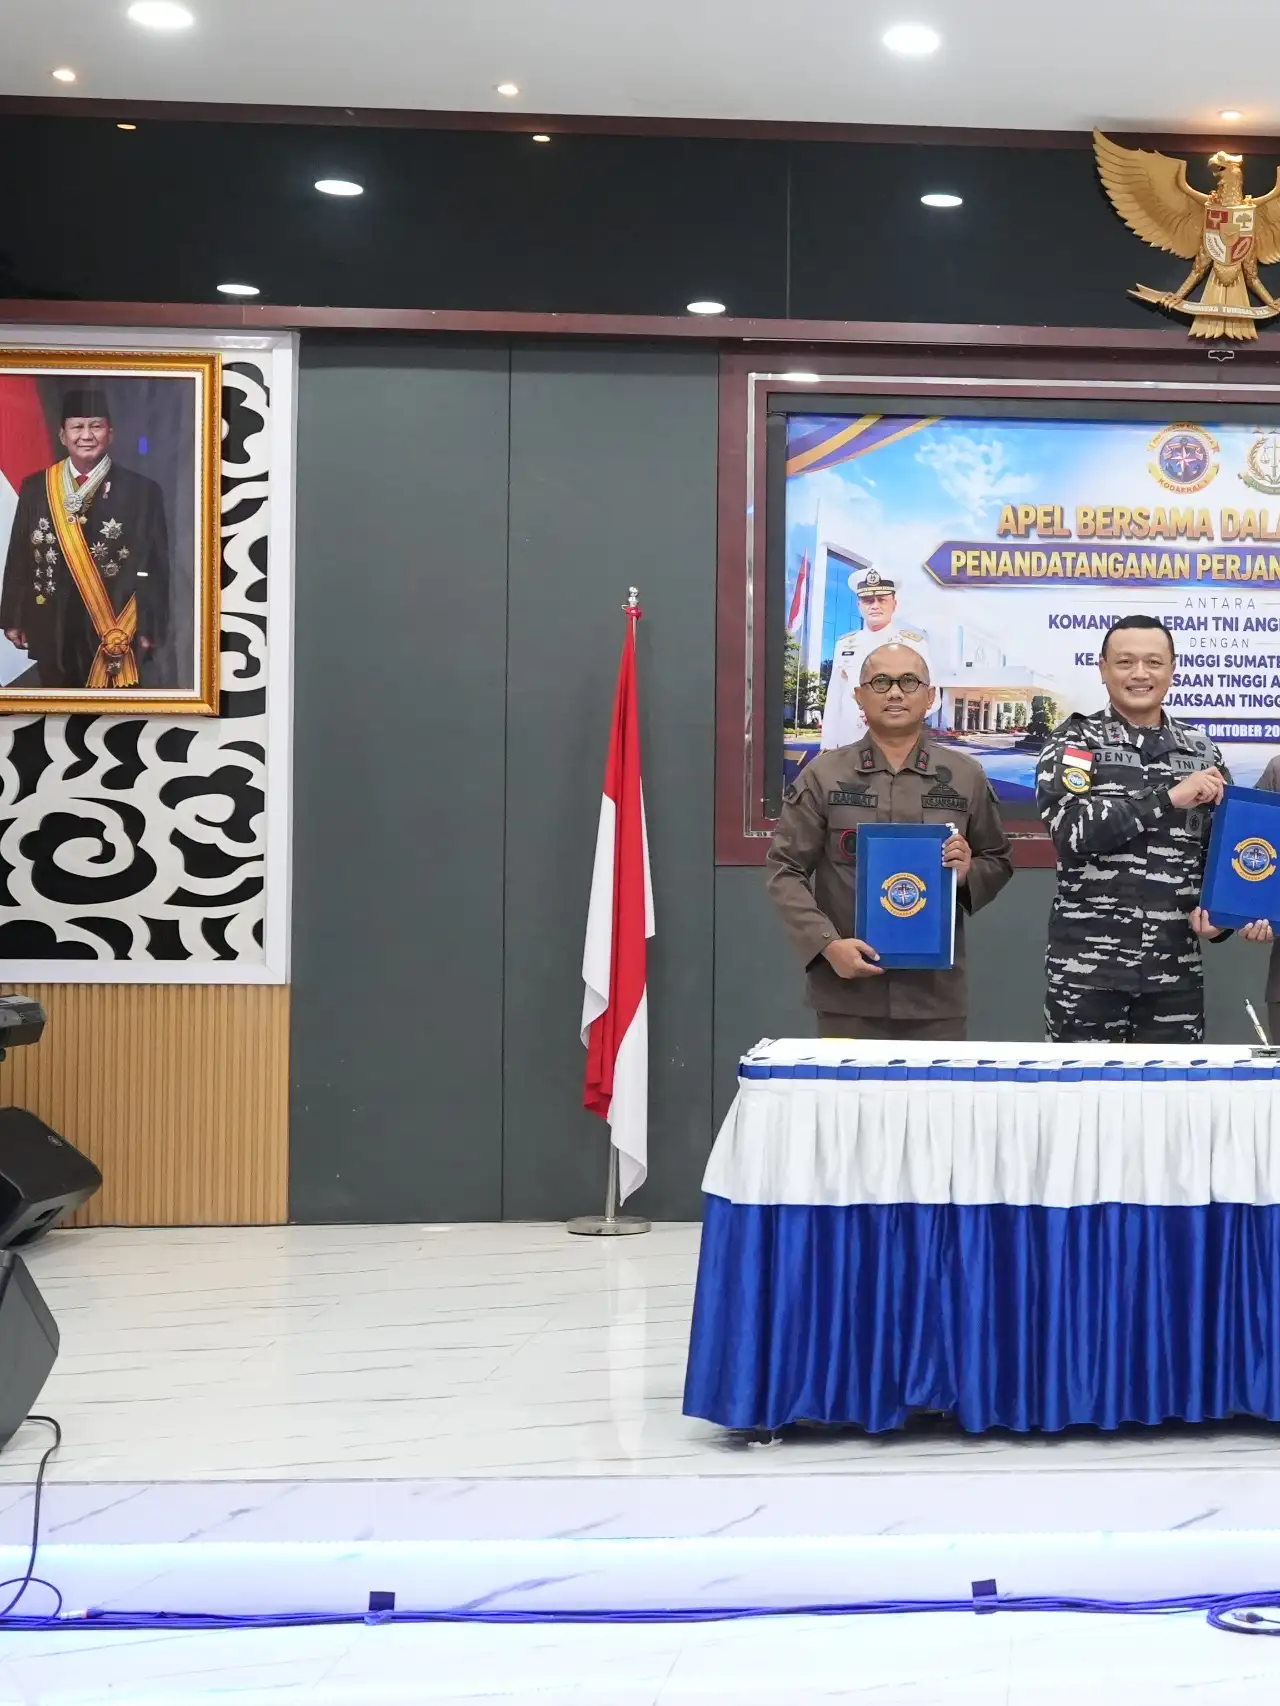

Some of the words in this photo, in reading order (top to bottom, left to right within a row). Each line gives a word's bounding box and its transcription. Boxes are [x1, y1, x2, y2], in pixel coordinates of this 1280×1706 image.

[997, 504, 1071, 538] APEL
[1077, 505, 1214, 541] BERSAMA
[951, 550, 1190, 579] PENANDATANGANAN
[1184, 597, 1256, 610] ANTARA
[1049, 614, 1123, 629] KOMAND
[1211, 616, 1239, 632] TNI
[1189, 637, 1249, 649] DENGAN
[1217, 674, 1267, 688] TINGGI
[1208, 724, 1262, 737] OKTOBER
[1094, 751, 1133, 763] DENY
[1175, 760, 1195, 769] TNI
